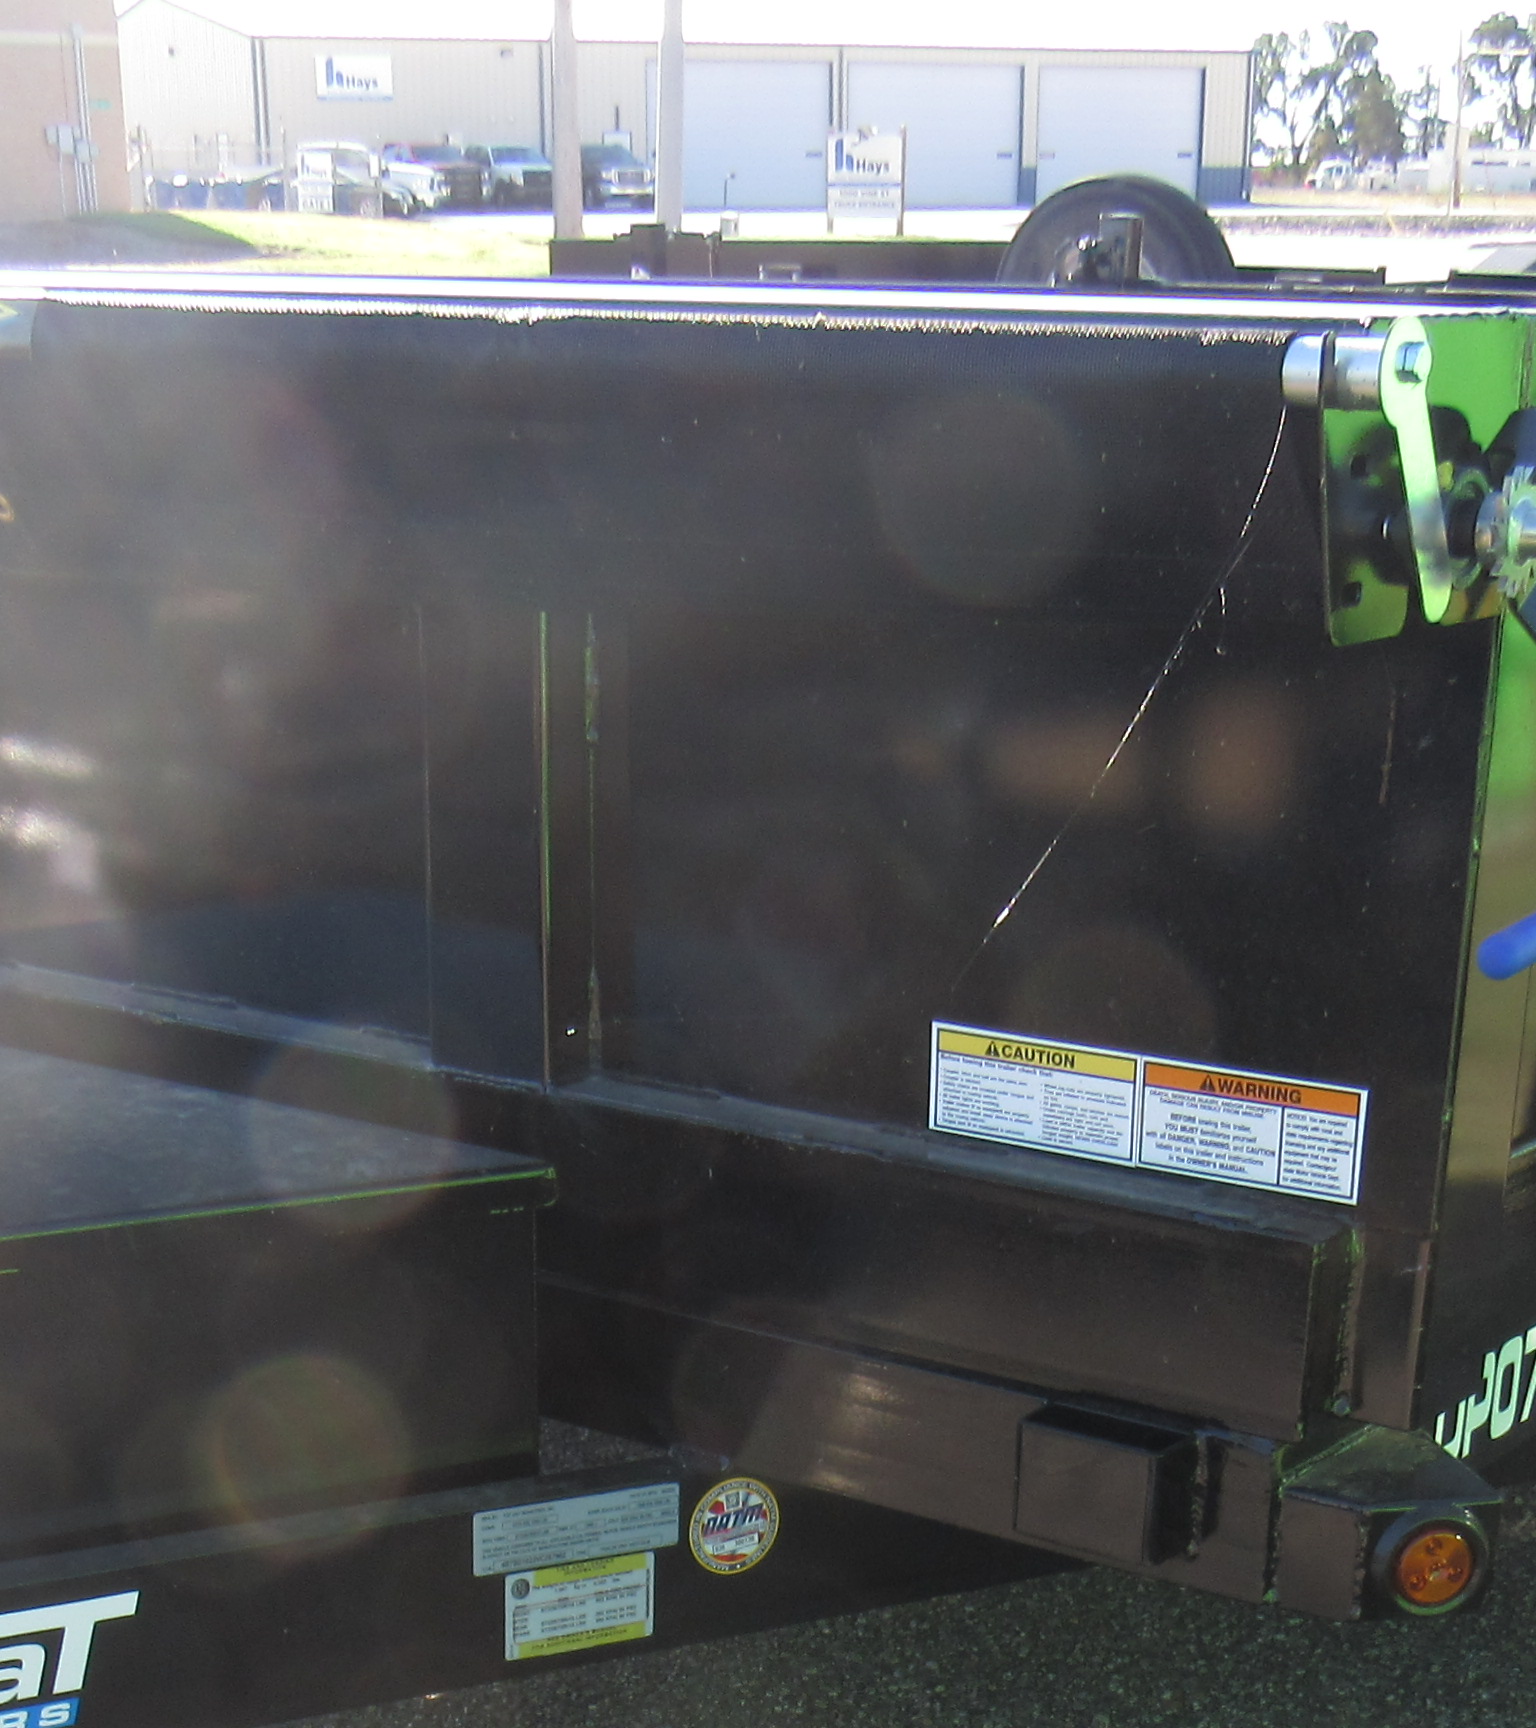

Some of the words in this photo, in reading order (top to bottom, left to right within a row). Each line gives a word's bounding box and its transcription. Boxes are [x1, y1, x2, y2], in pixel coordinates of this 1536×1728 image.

[346, 75, 379, 91] Hays
[856, 157, 890, 176] Hays
[1001, 1044, 1076, 1069] CAUTION
[1218, 1076, 1302, 1105] WARNING
